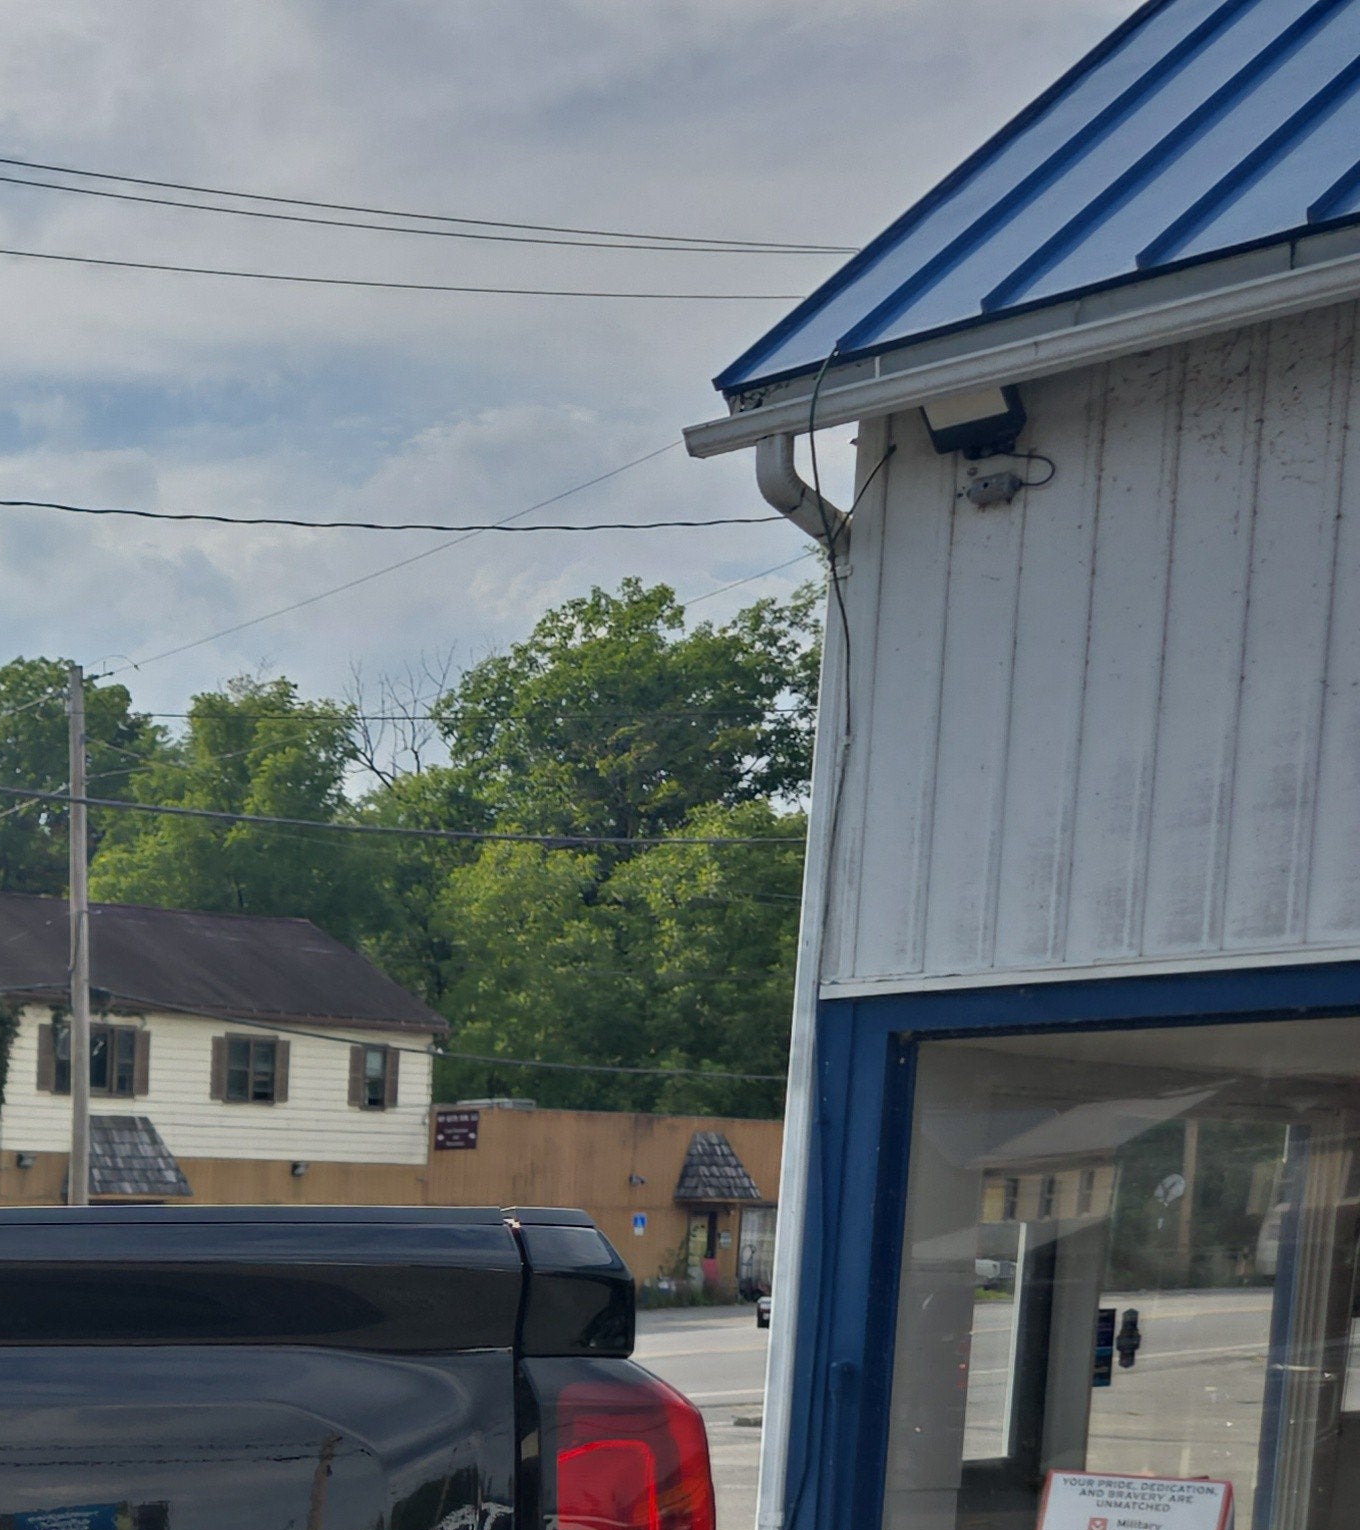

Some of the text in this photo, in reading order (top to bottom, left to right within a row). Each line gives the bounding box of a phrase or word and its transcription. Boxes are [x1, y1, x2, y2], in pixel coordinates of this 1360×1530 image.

[1062, 1477, 1095, 1488] YOUR
[1140, 1482, 1218, 1496] DEDICATION,
[1079, 1488, 1194, 1505] AND BRAVERY ARE
[1095, 1500, 1171, 1513] UNMATCHED
